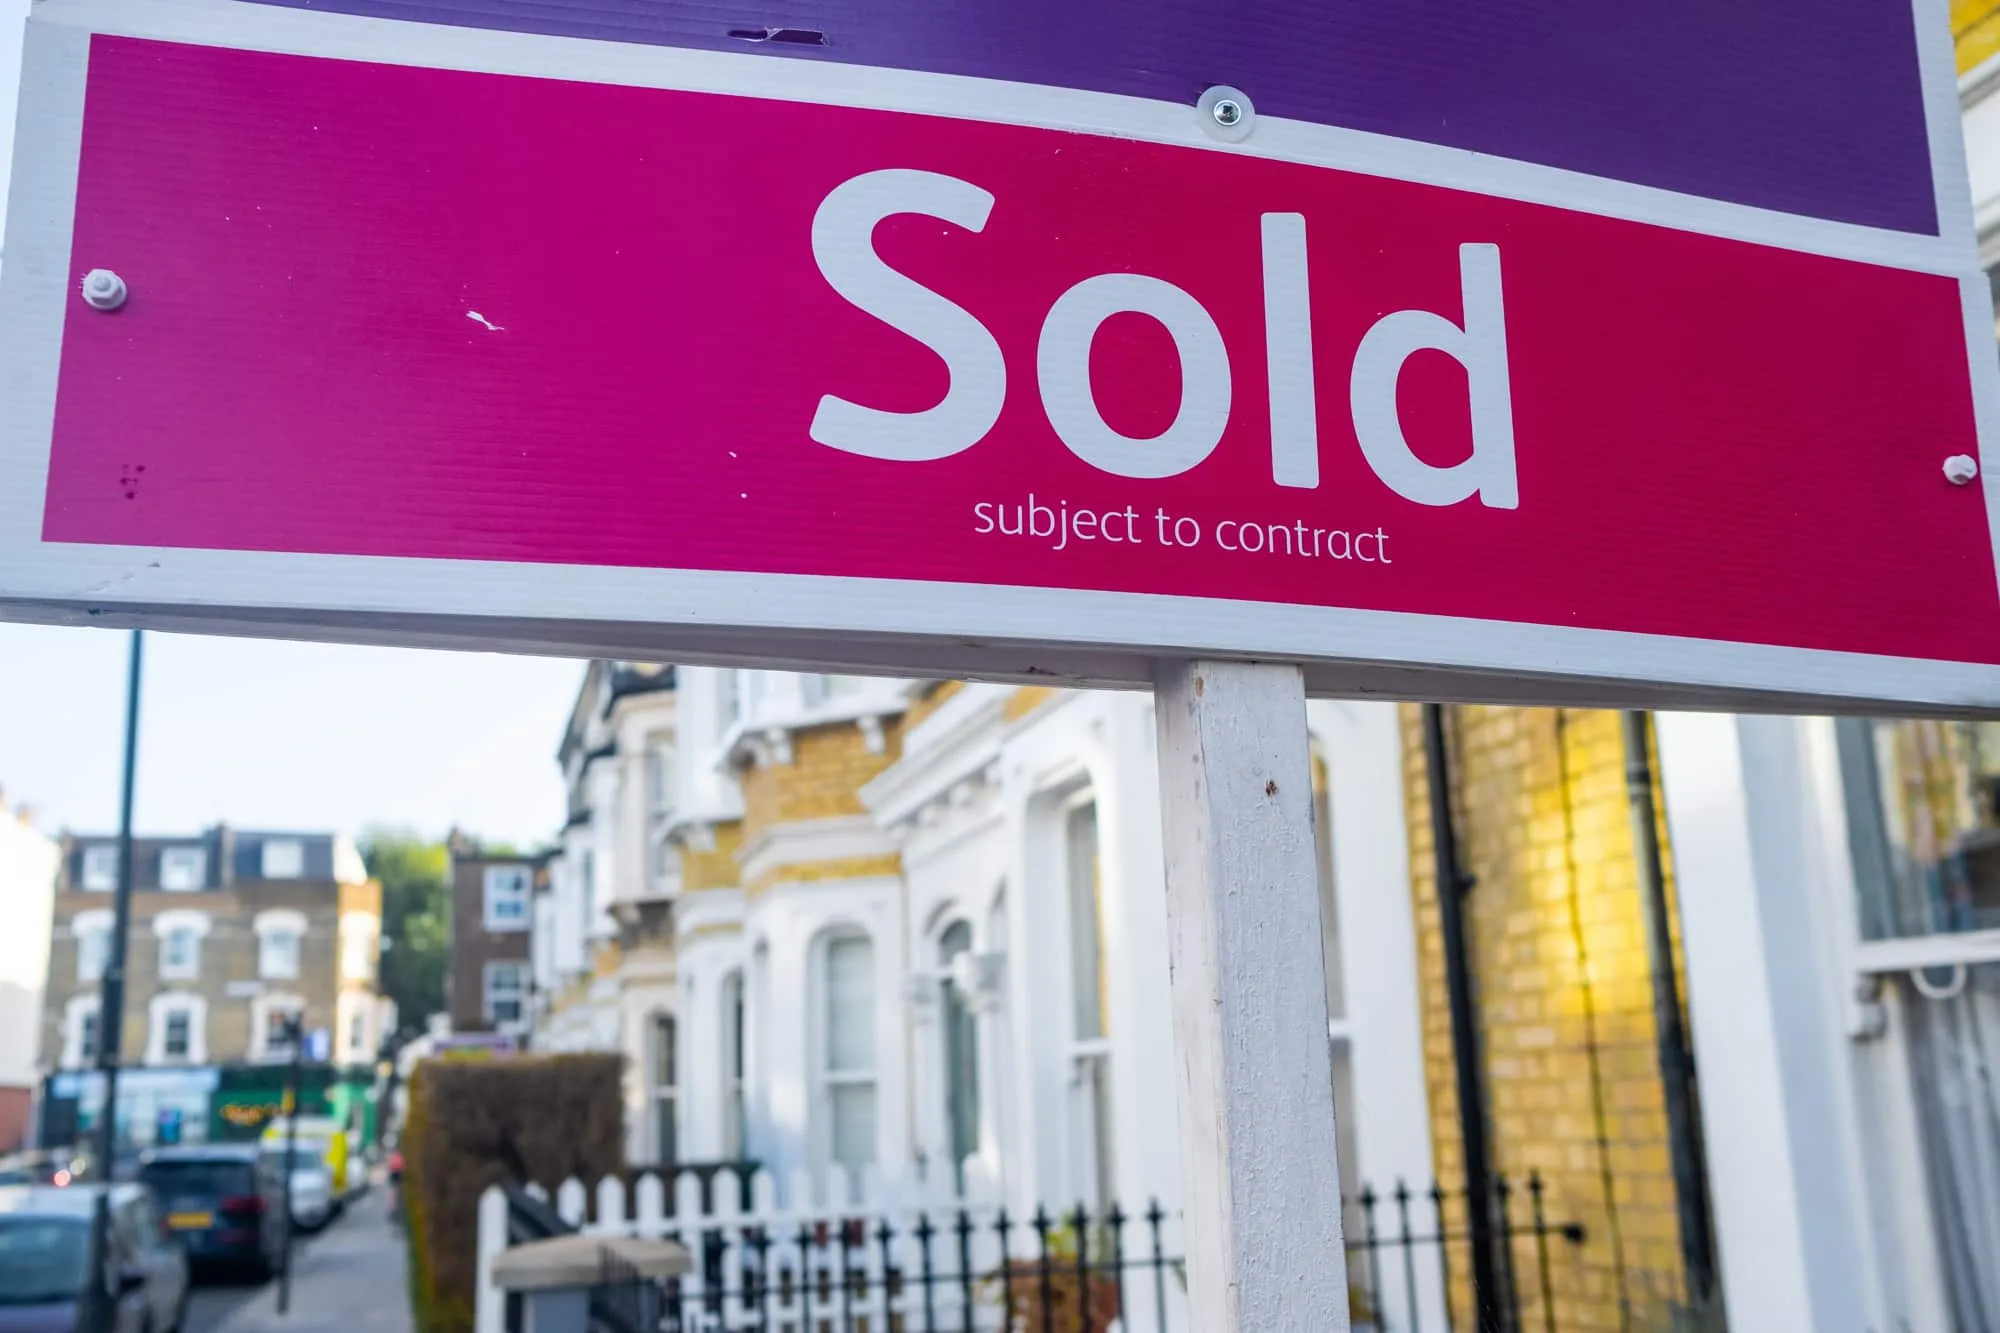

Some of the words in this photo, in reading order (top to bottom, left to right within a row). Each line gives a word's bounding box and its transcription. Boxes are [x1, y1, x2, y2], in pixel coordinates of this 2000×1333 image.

[809, 168, 1520, 511] Sold
[973, 493, 1143, 551] subject
[1154, 506, 1202, 548] to
[1215, 518, 1393, 565] contract
